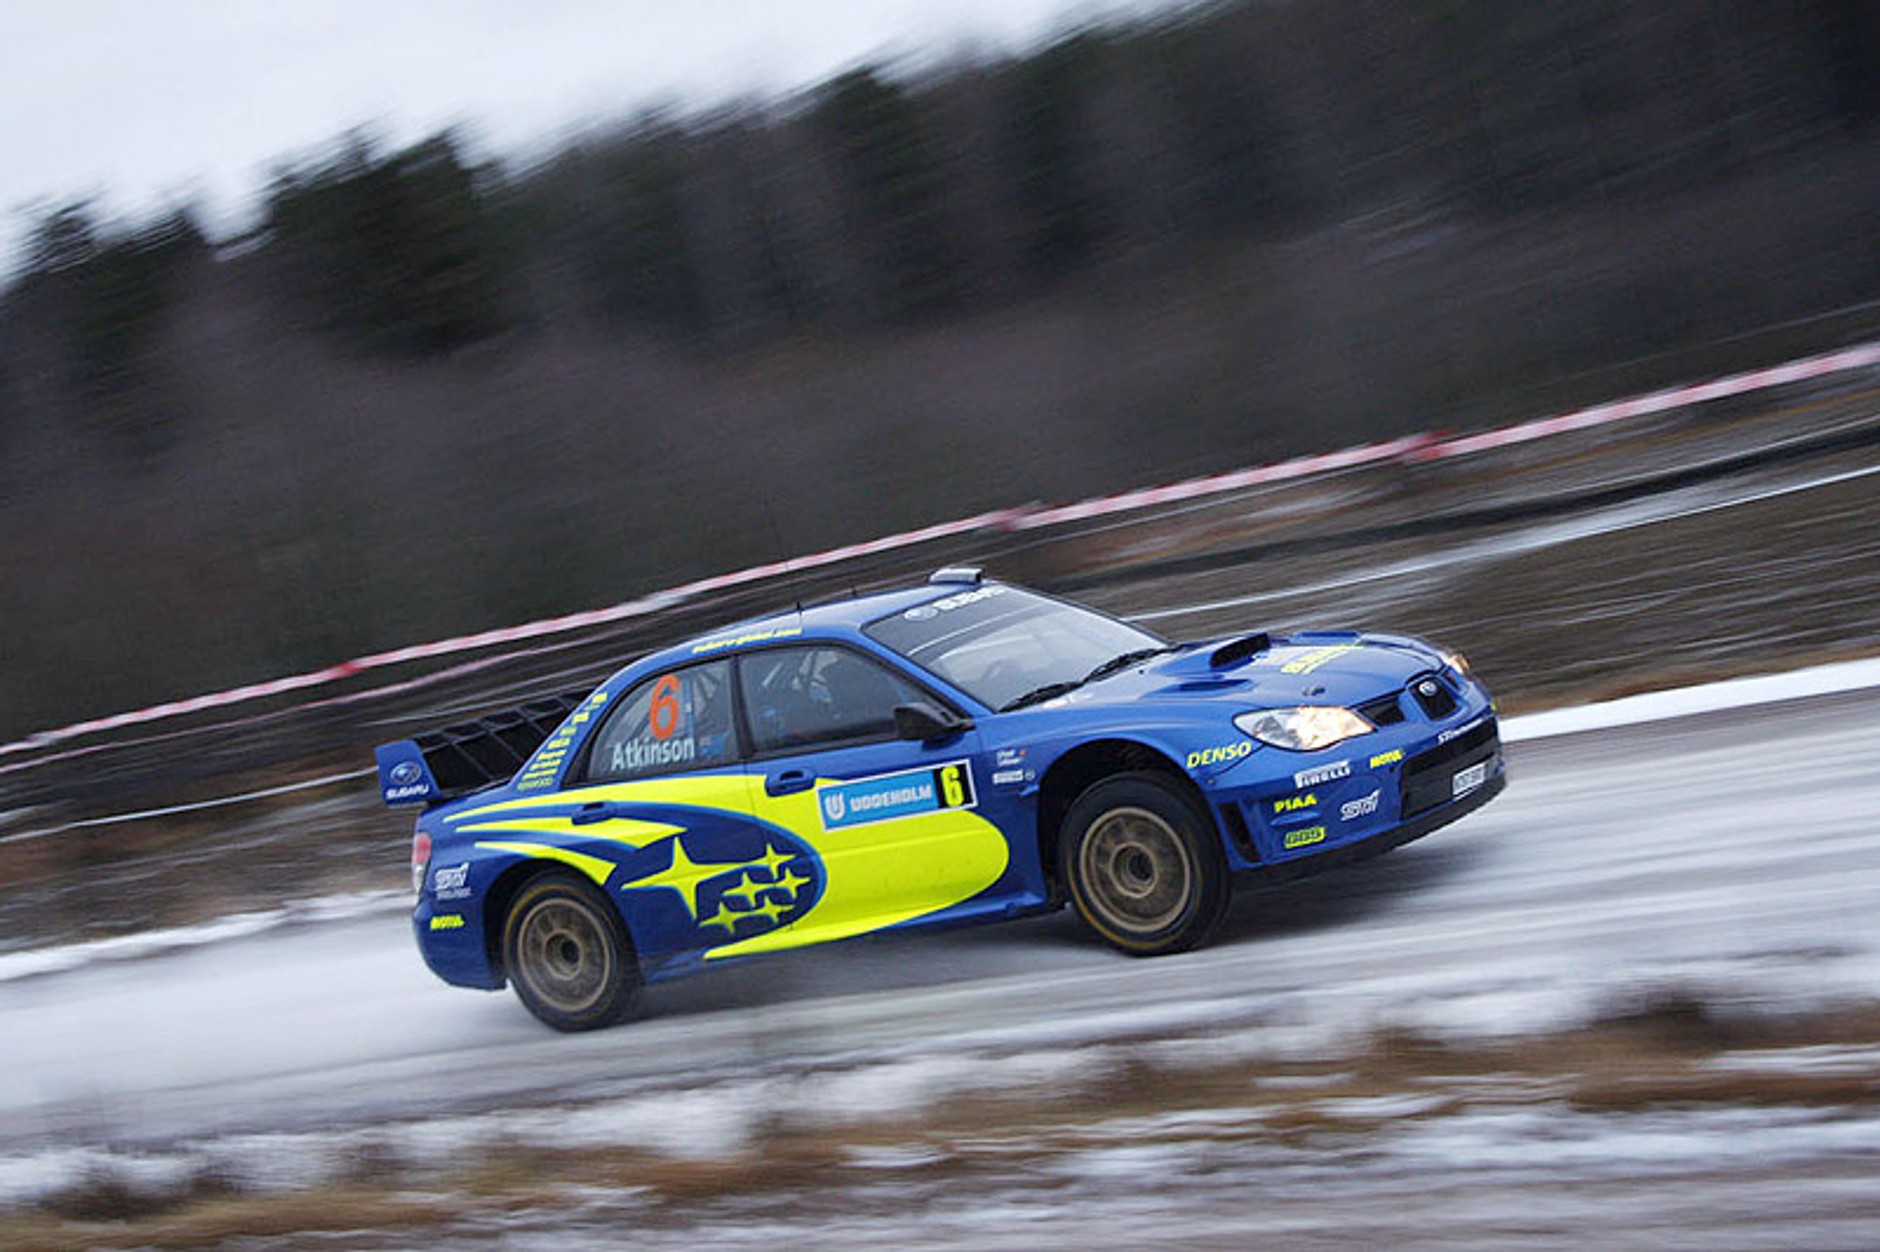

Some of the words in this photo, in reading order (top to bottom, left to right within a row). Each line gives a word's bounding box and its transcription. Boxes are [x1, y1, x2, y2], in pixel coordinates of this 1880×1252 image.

[649, 674, 679, 740] 6
[611, 736, 695, 771] Atkinson
[1186, 741, 1252, 768] DENSO
[940, 765, 965, 807] 6
[1274, 793, 1318, 813] PIAA
